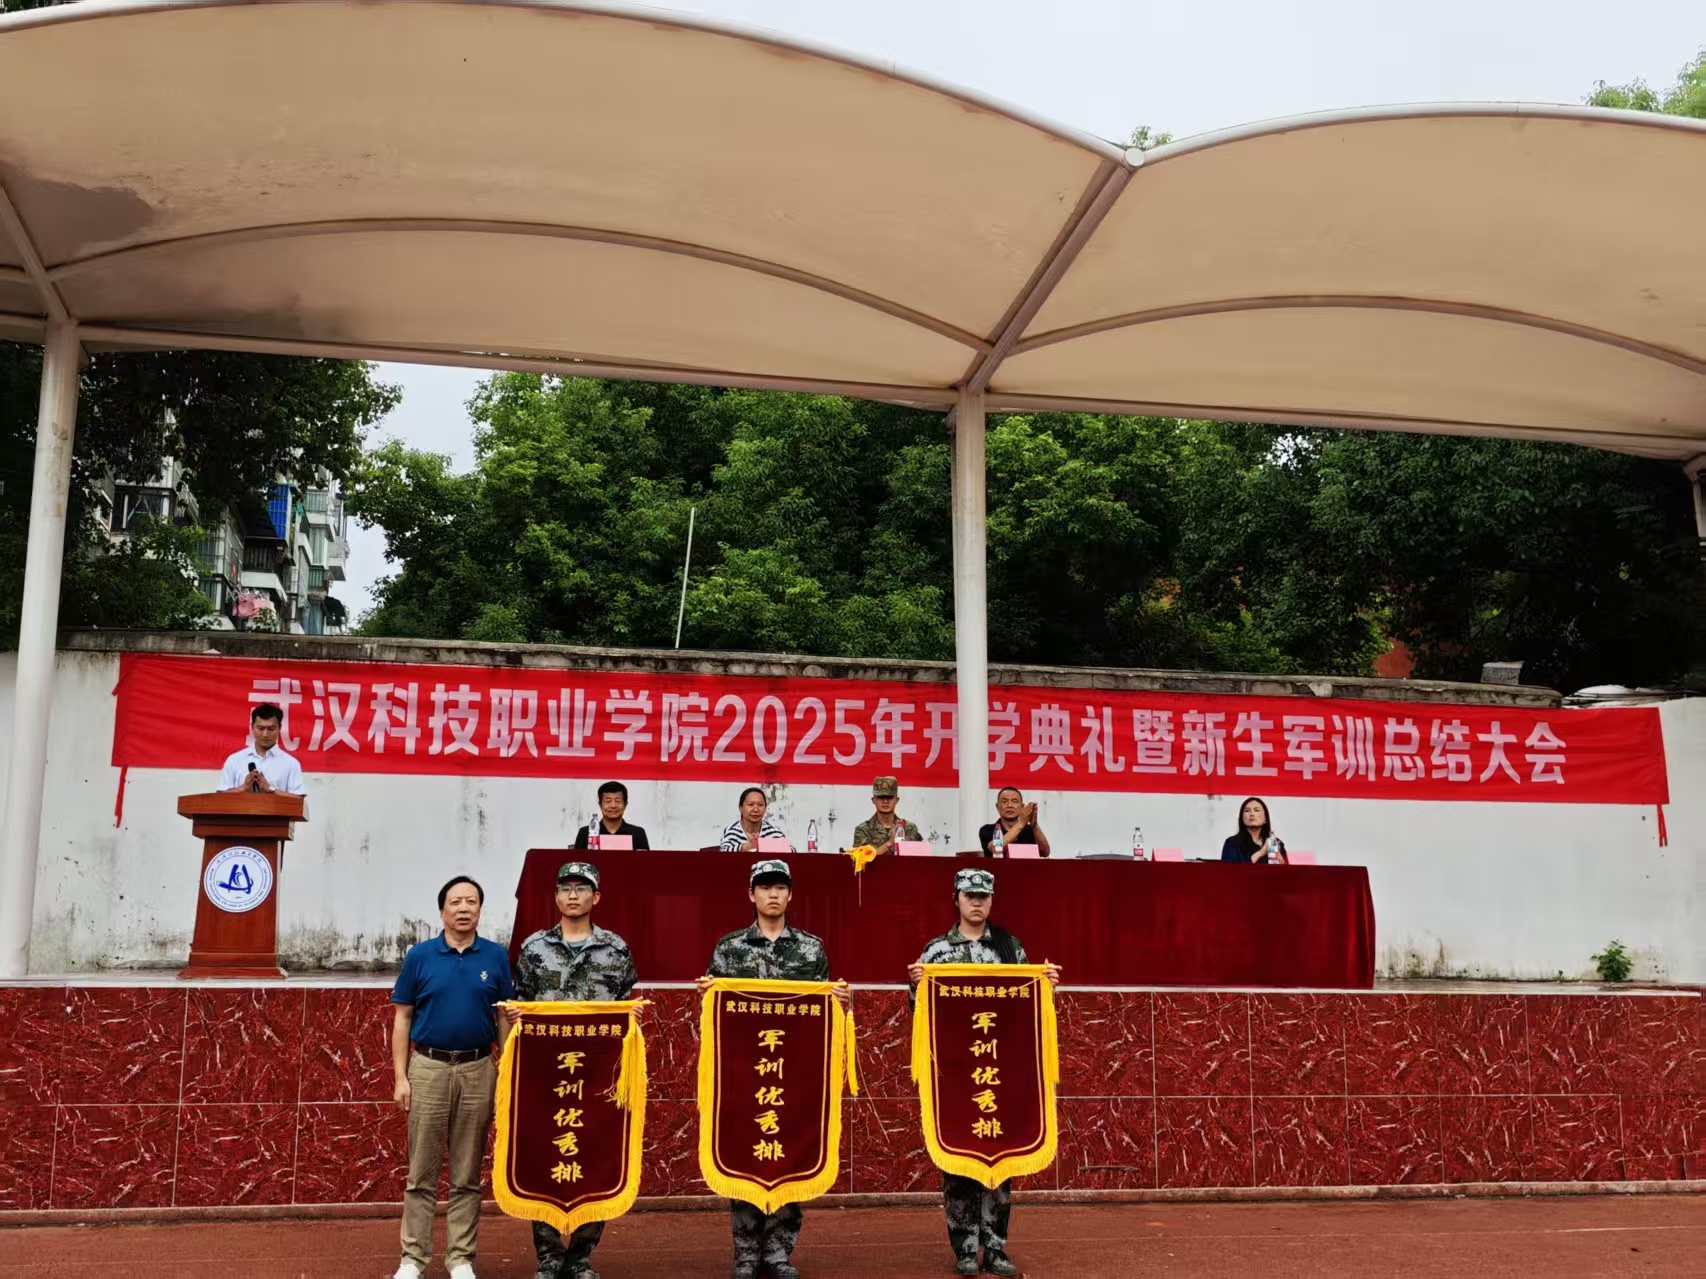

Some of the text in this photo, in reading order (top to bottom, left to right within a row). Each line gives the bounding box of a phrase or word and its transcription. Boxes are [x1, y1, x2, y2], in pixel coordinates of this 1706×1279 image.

[245, 677, 1566, 784] 武汉科技职业学院2025年开学典礼暨新生军训总结大会
[523, 1023, 623, 1037] 武汉科技职业学院
[725, 1000, 821, 1016] 武汉科技职业学院
[939, 985, 1030, 999] 武汉科技职业学院
[551, 1051, 586, 1184] 军训优秀排
[753, 1029, 785, 1161] 军训优秀排
[969, 1011, 1003, 1139] 军训优秀排
